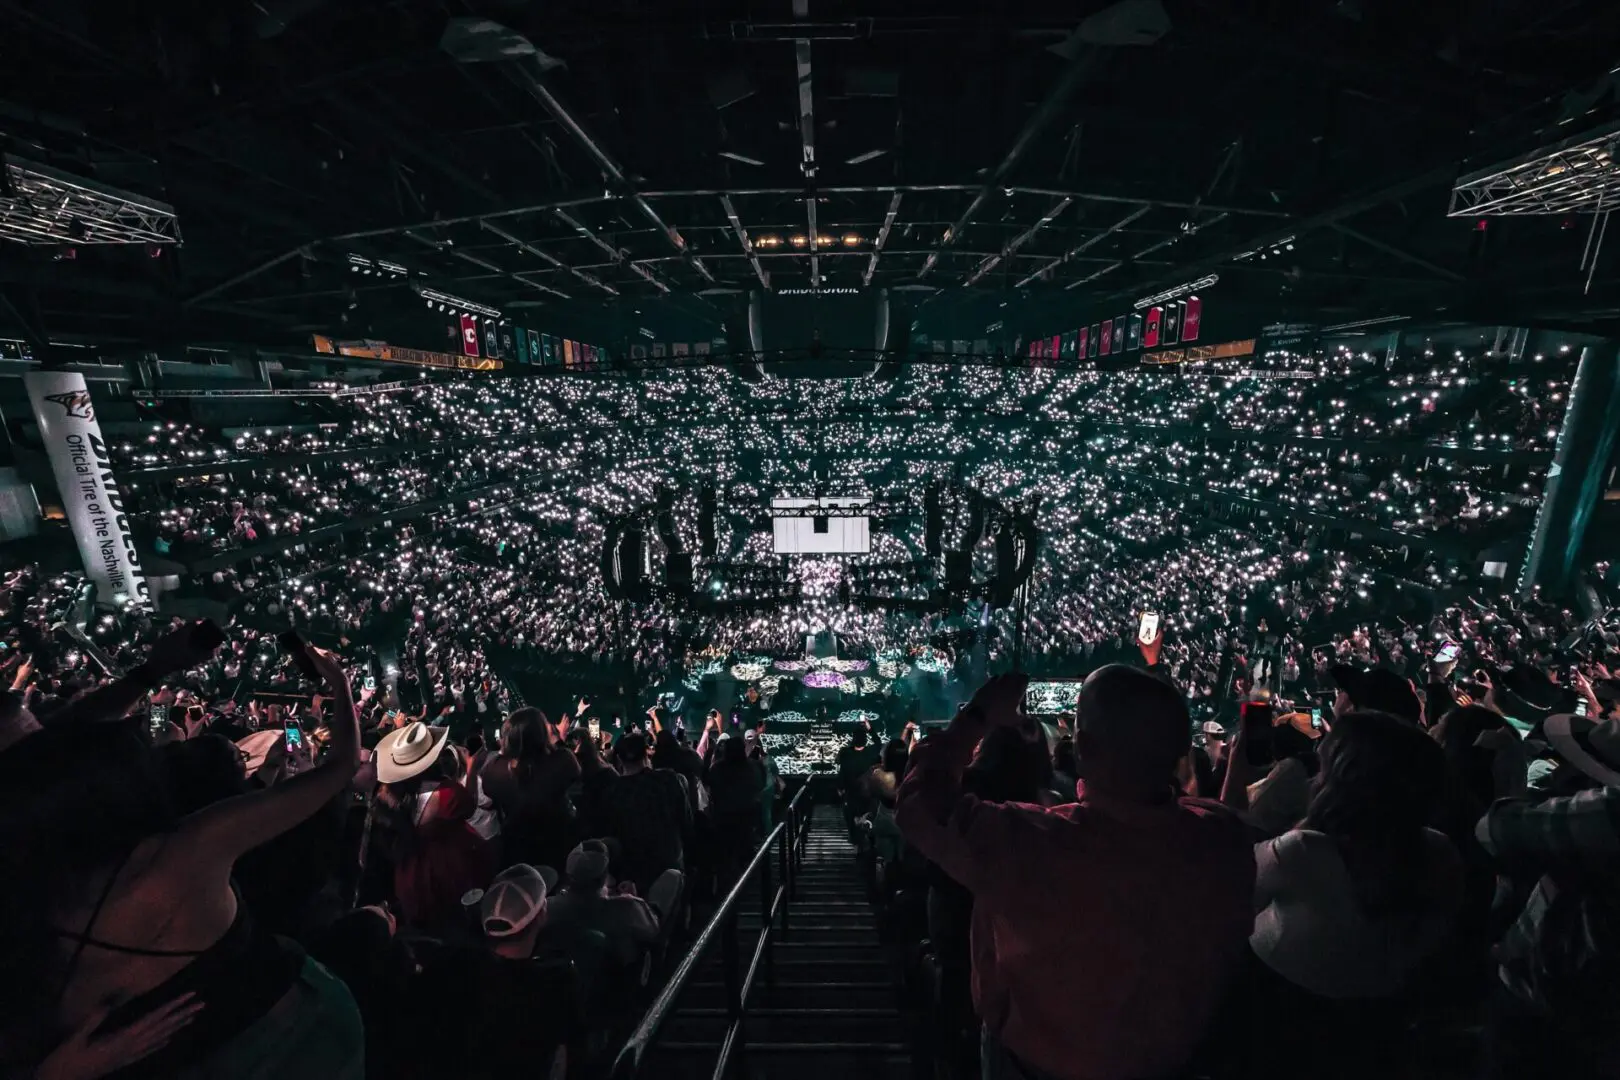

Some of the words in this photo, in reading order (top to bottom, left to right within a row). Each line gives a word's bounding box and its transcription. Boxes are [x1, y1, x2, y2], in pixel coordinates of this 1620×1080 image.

[66, 433, 92, 477] Official
[80, 477, 98, 501] Tire
[88, 503, 103, 515] of
[92, 516, 108, 537] the
[99, 539, 123, 588] Nashville
